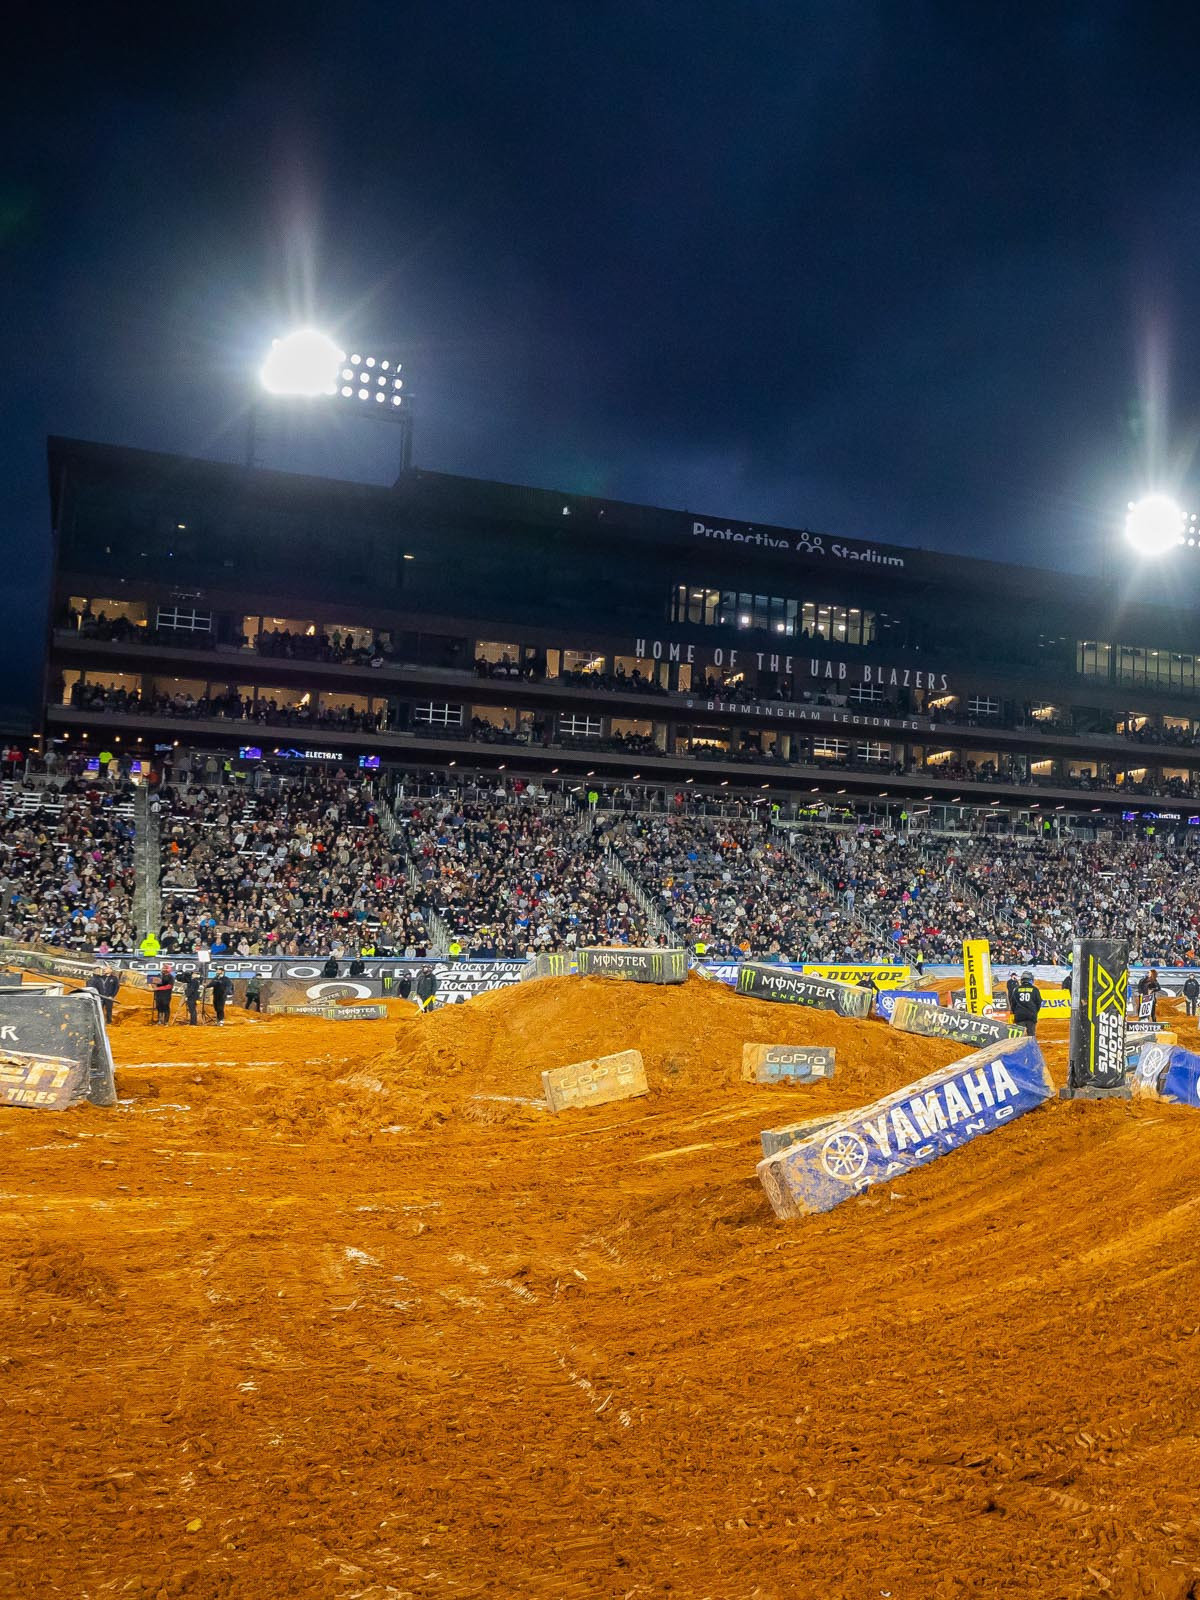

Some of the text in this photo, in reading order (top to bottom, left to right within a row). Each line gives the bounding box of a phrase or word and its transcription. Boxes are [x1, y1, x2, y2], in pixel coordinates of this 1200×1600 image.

[693, 522, 905, 567] Protective Stadium
[636, 638, 948, 691] HOME OF THE UAB BLAZERS
[707, 701, 919, 730] BIRMINGHAM LEGION FC
[305, 751, 343, 760] ELECTRA'S
[129, 961, 197, 973] GoPro
[208, 961, 273, 972] GoPro
[451, 962, 491, 971] ROCKY
[593, 953, 647, 968] MONSTER
[287, 967, 418, 979] OAKEY
[827, 971, 903, 981] DUNLOP
[966, 946, 978, 1014] LEADE
[440, 981, 482, 991] ROCKY
[761, 975, 836, 1001] MONSTER
[771, 992, 825, 1007] ENERGY
[1019, 992, 1031, 1002] 30
[924, 1010, 1000, 1039] MONSTER
[1098, 1011, 1110, 1074] SUPER
[1108, 1014, 1118, 1070] MOTO
[766, 1052, 826, 1065] GoPro
[559, 1064, 633, 1088] GoPro
[7, 1088, 59, 1104] TIRES
[863, 1060, 1020, 1158] YAMAHA
[854, 1106, 1014, 1190] RACING
